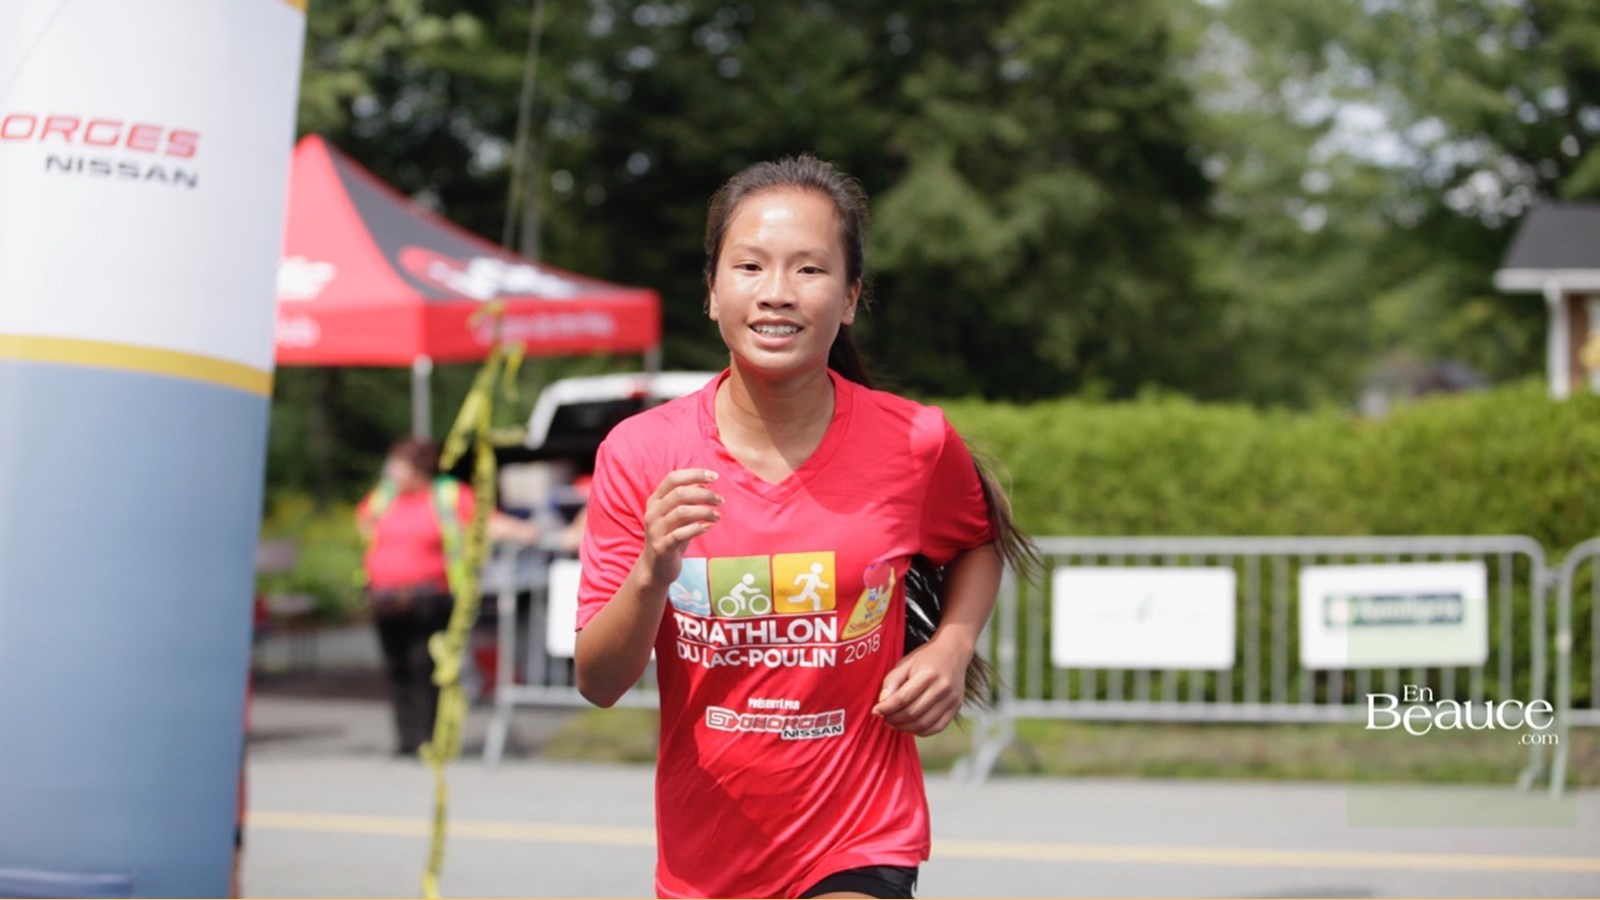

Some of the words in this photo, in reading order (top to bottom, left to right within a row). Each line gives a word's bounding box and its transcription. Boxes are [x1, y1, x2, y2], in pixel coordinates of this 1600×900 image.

[1, 114, 199, 159] ORGES
[45, 155, 198, 187] NISSAN
[673, 613, 838, 645] TRIATHLON
[677, 640, 700, 662] DU
[702, 647, 836, 669] LAC-POULIN
[844, 634, 881, 664] 2018
[784, 700, 800, 710] PAR
[740, 712, 844, 731] GEORGES
[783, 725, 843, 738] NISSAN
